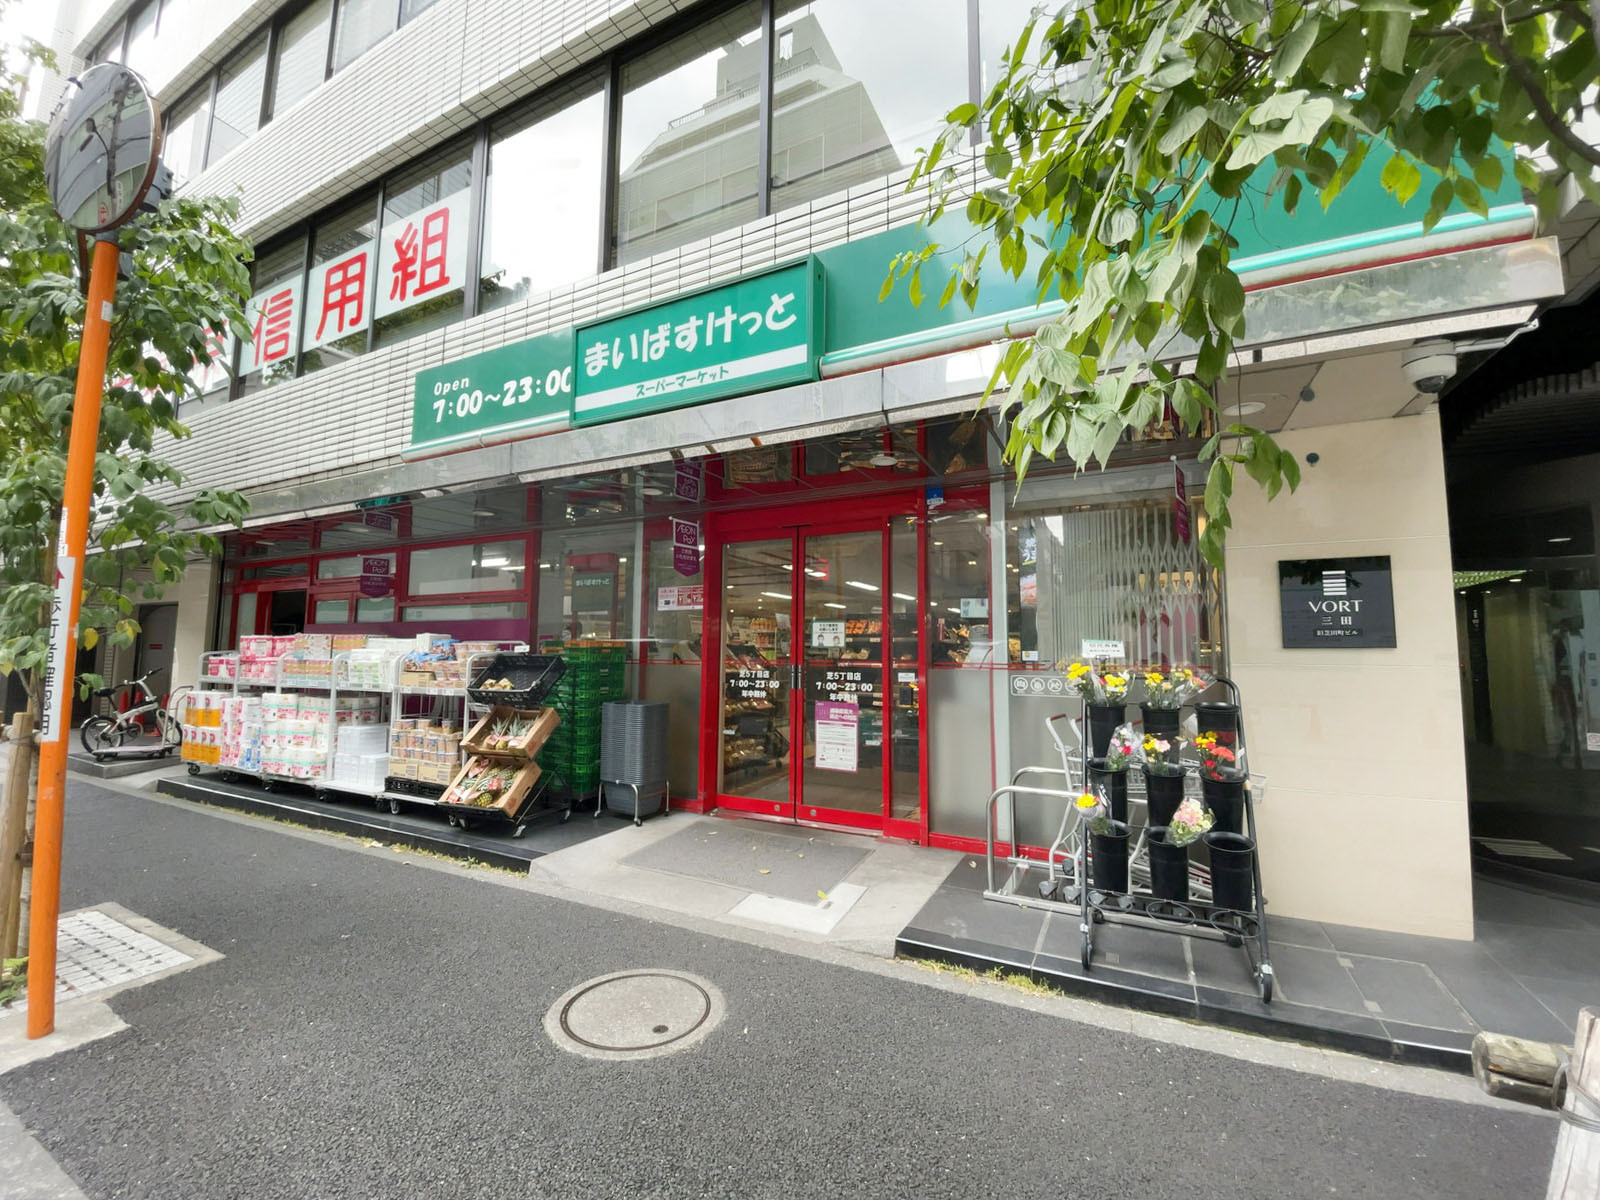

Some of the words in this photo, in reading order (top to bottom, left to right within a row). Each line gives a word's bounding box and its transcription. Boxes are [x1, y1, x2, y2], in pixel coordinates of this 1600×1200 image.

[584, 292, 797, 376] まいばすけっと
[434, 377, 470, 397] Open
[636, 365, 729, 397] スーパーマーケット
[1308, 600, 1363, 613] VORT
[739, 670, 770, 678] 芝5丁目店
[826, 672, 862, 681] 芝5丁目店
